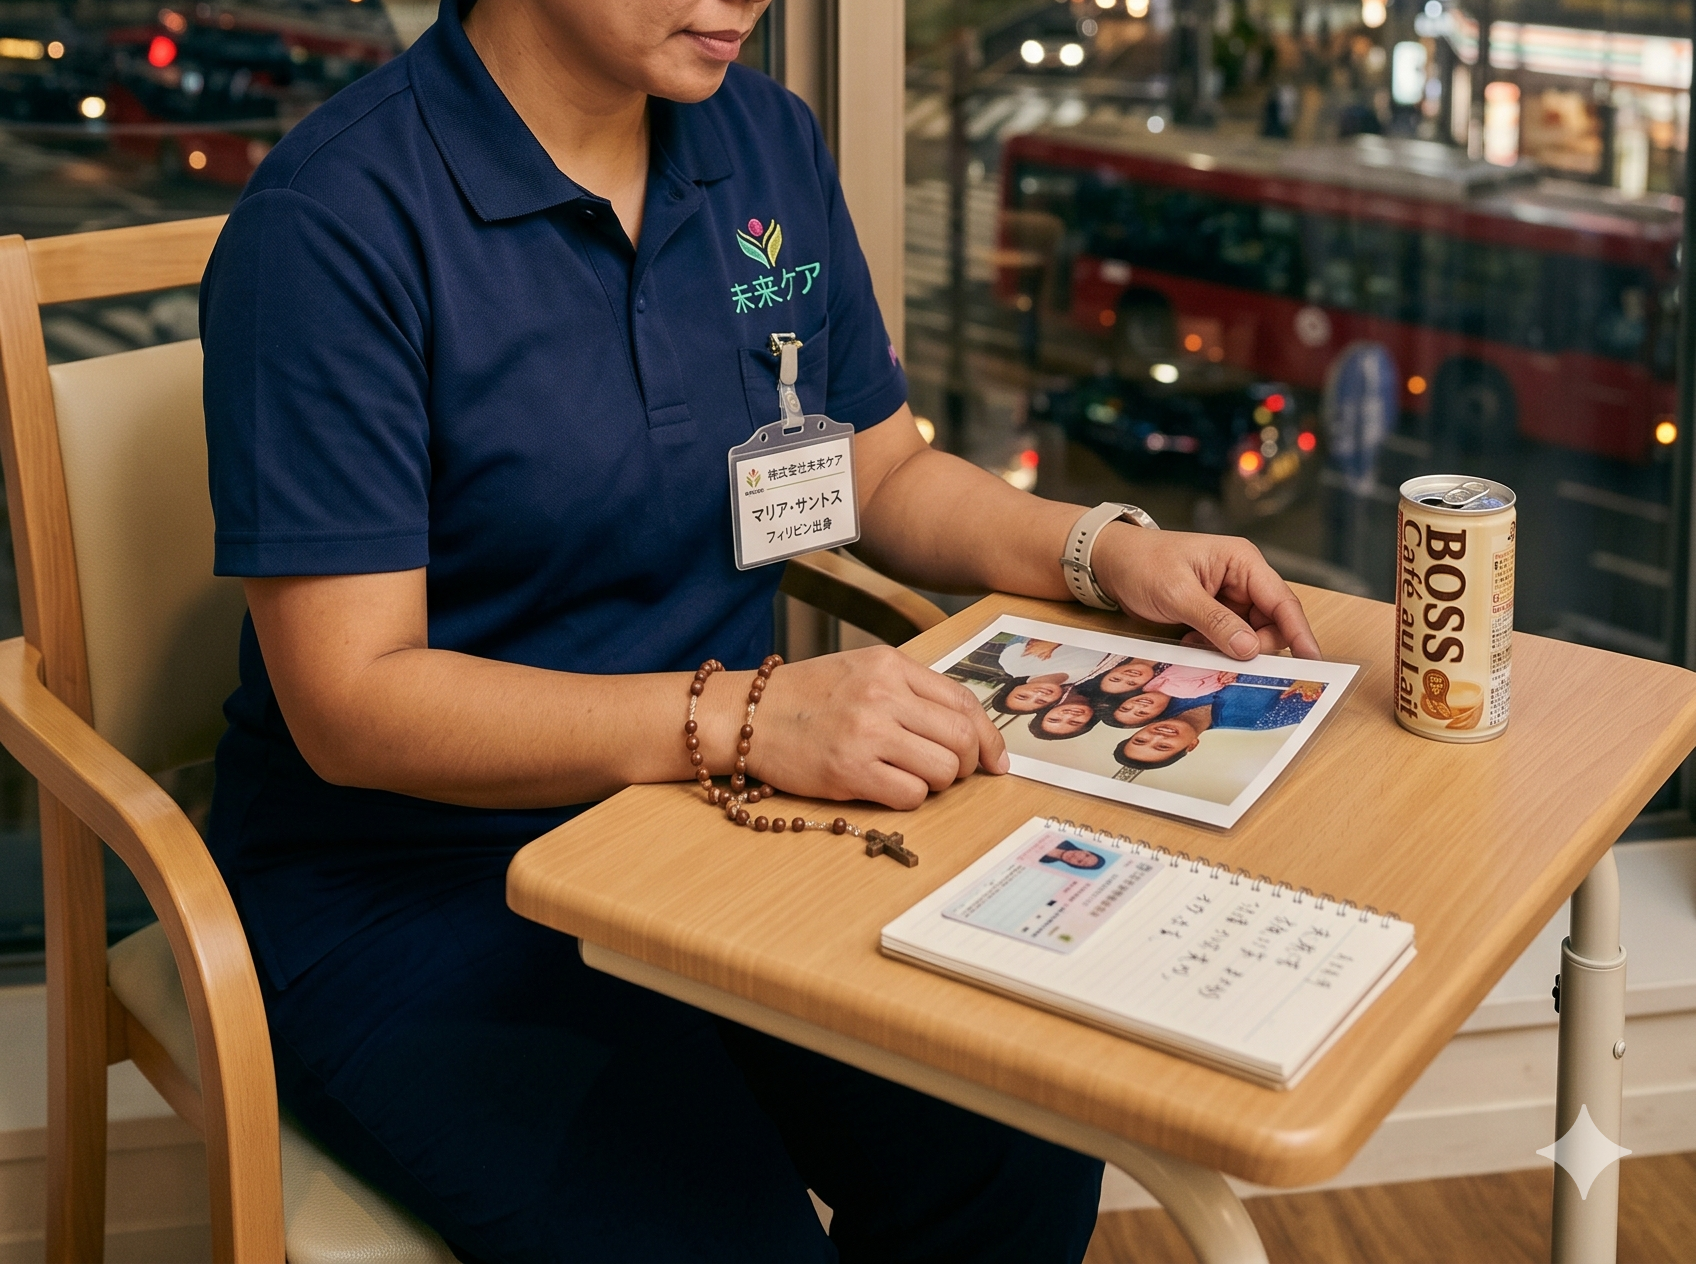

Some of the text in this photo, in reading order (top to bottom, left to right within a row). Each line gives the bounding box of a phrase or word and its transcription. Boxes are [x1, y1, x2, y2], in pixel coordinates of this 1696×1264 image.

[730, 262, 821, 314] 未来ケア
[752, 489, 843, 523] マリア・サントス
[1399, 519, 1423, 720] Café au Lait
[1422, 524, 1467, 664] BOSS
